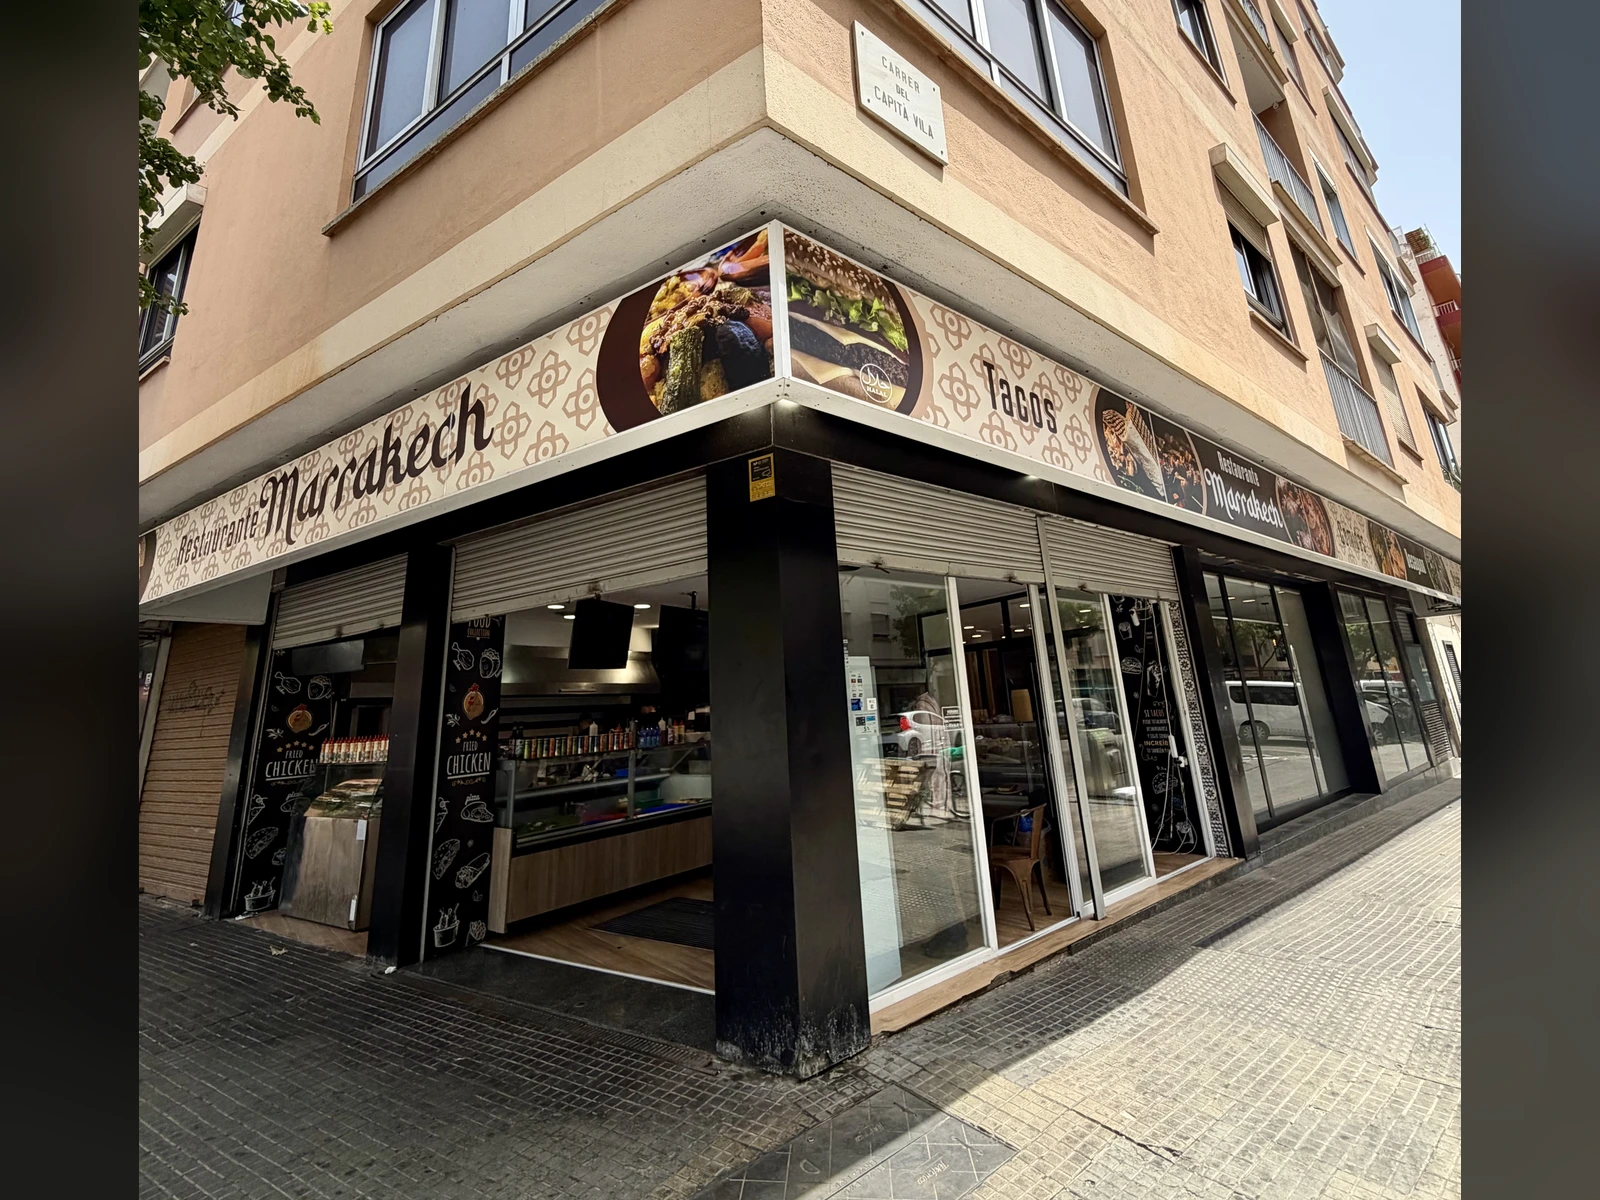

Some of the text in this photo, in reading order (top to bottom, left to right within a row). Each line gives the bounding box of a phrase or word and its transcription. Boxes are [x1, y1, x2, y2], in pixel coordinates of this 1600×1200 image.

[881, 55, 920, 94] CARRER
[895, 84, 910, 102] DEL
[913, 113, 935, 140] VILA
[866, 385, 888, 399] HALAL
[175, 381, 495, 567] Restaurante Marrakech
[1216, 450, 1260, 488] Restaurante
[1203, 467, 1284, 529] Marrakech
[285, 749, 304, 759] FRIED
[462, 740, 479, 752] FRIED
[446, 751, 491, 775] CHICKEN
